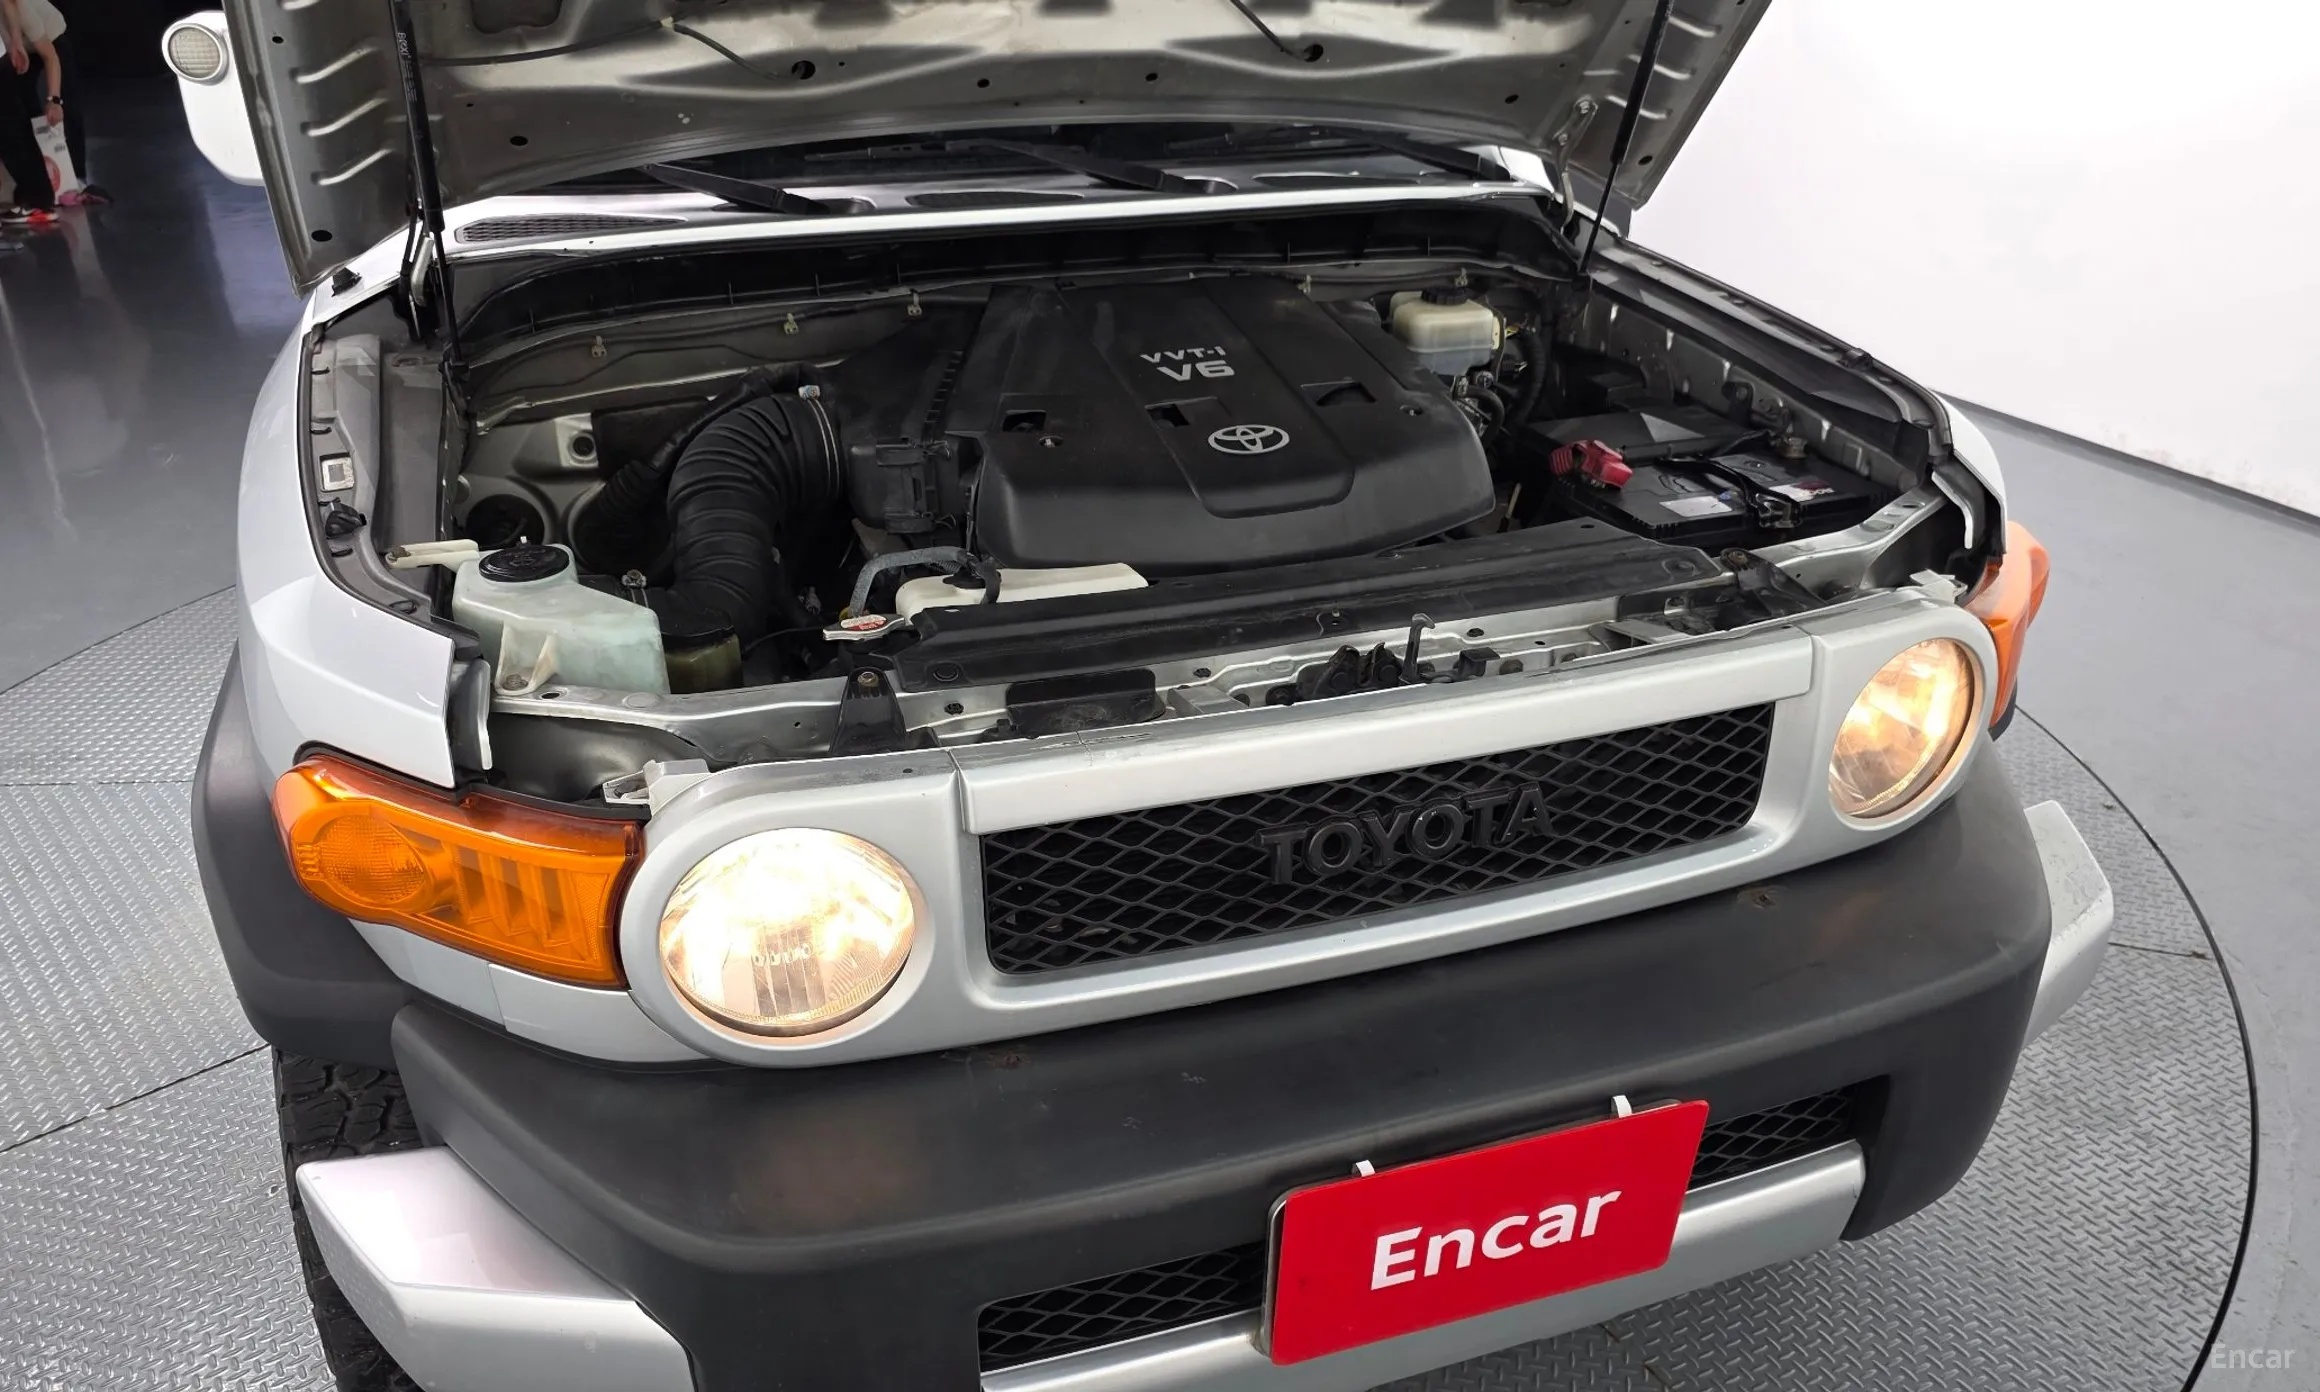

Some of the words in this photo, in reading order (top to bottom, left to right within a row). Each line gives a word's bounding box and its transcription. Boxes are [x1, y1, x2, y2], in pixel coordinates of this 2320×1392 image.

[1156, 360, 1235, 382] V6
[1256, 782, 1554, 884] TOYOTA
[1370, 1190, 1622, 1291] Encar
